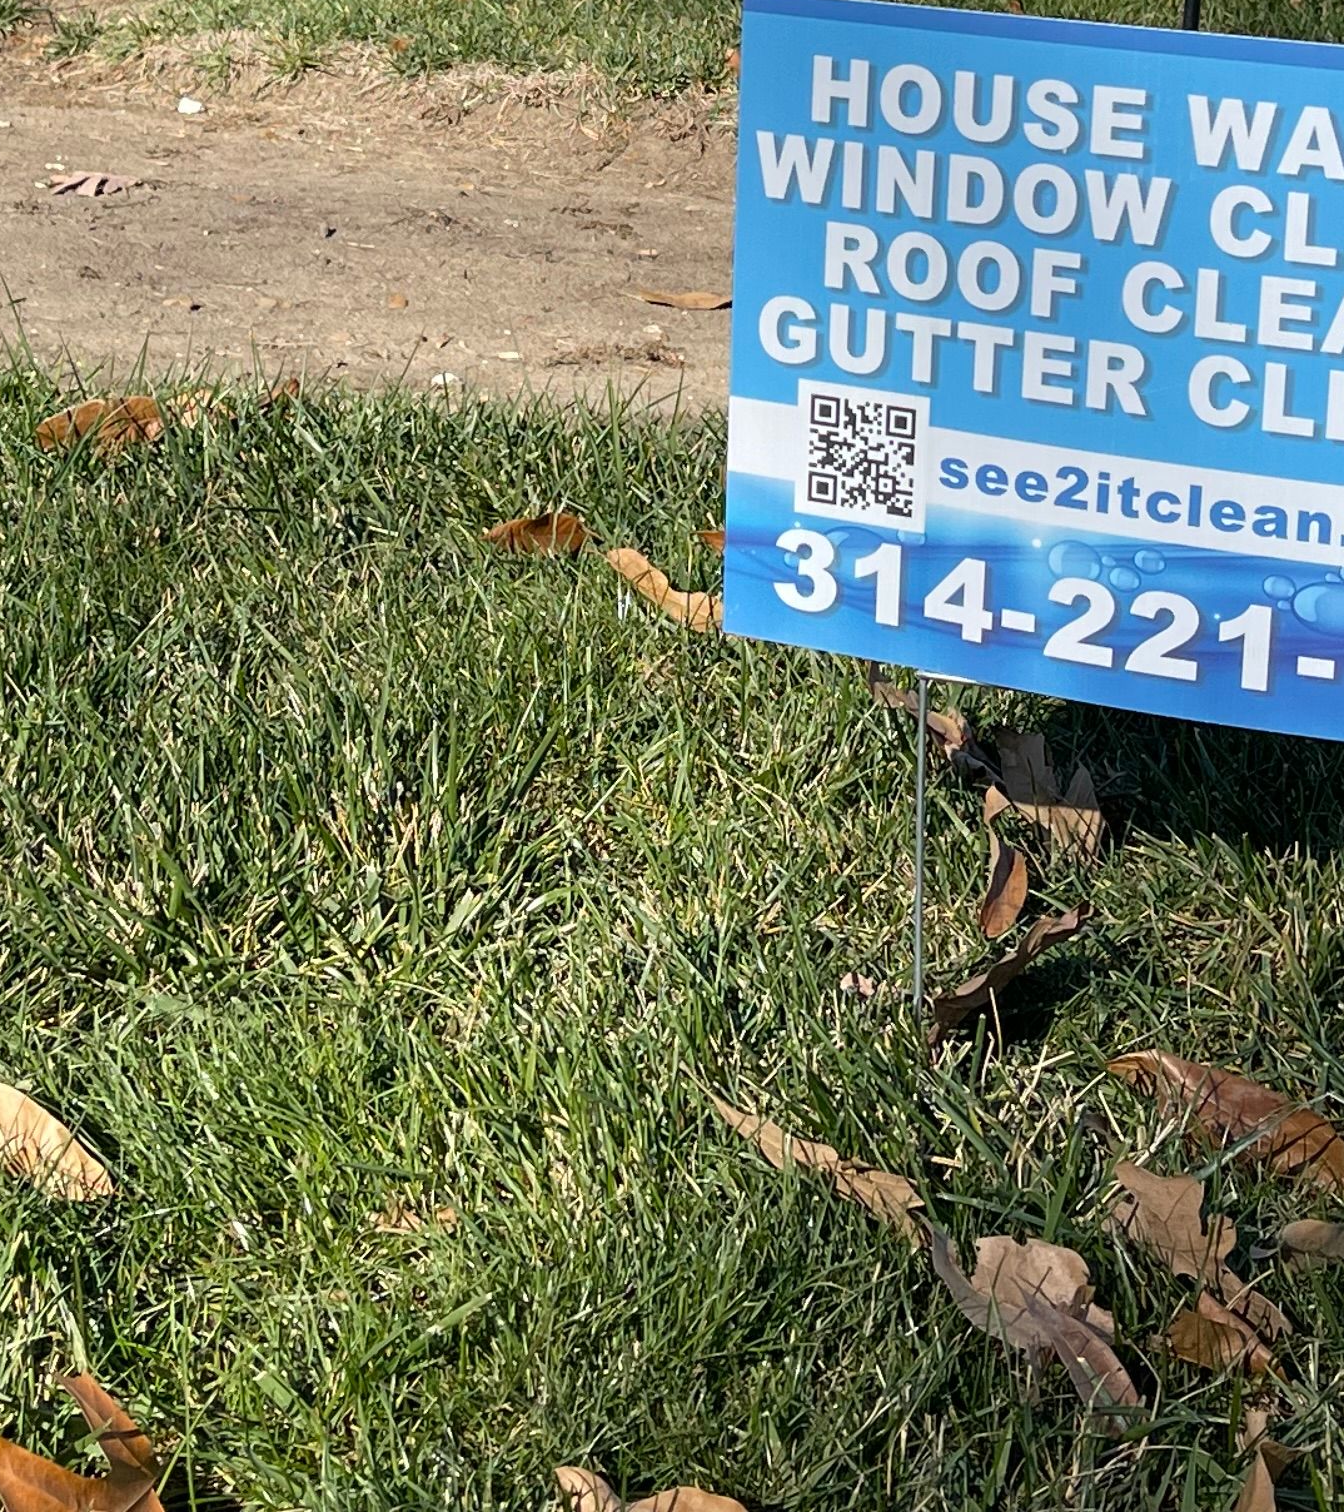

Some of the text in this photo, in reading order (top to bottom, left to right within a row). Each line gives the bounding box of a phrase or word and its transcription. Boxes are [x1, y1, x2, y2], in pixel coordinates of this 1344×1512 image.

[812, 54, 1147, 159] HOUSE
[756, 130, 1172, 246] WINDOW
[823, 221, 1082, 319] ROOF
[758, 295, 1147, 416] GUTTER
